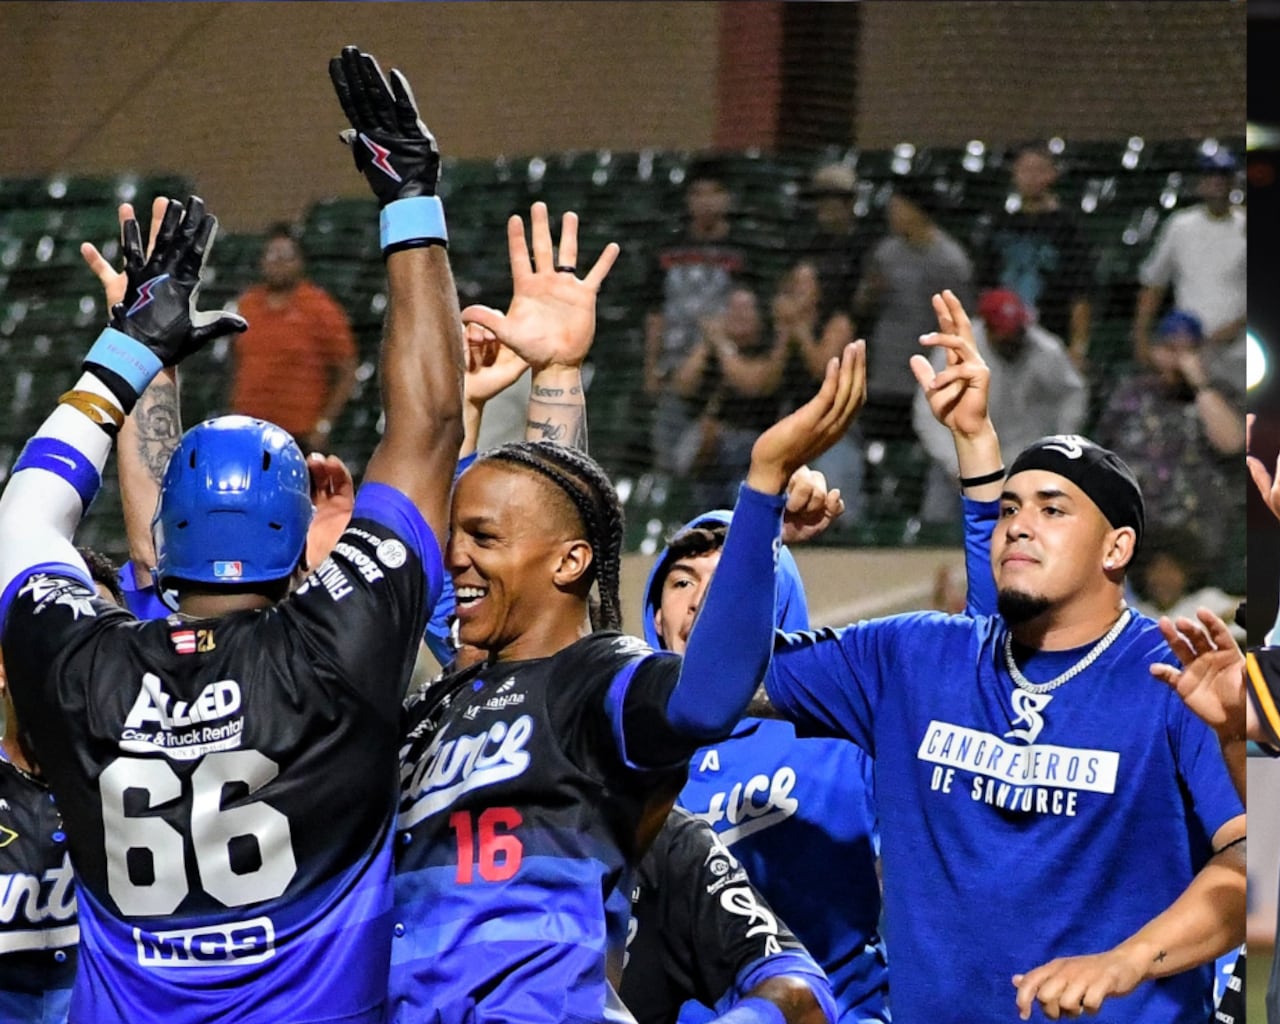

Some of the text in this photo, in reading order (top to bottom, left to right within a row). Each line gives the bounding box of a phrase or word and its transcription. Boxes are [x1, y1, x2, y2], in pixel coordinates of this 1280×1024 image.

[196, 629, 217, 652] 21
[926, 728, 1100, 784] CANGREJEROS
[930, 765, 1078, 817] DE SANTURCE
[100, 749, 298, 917] 66
[449, 807, 523, 885] 16
